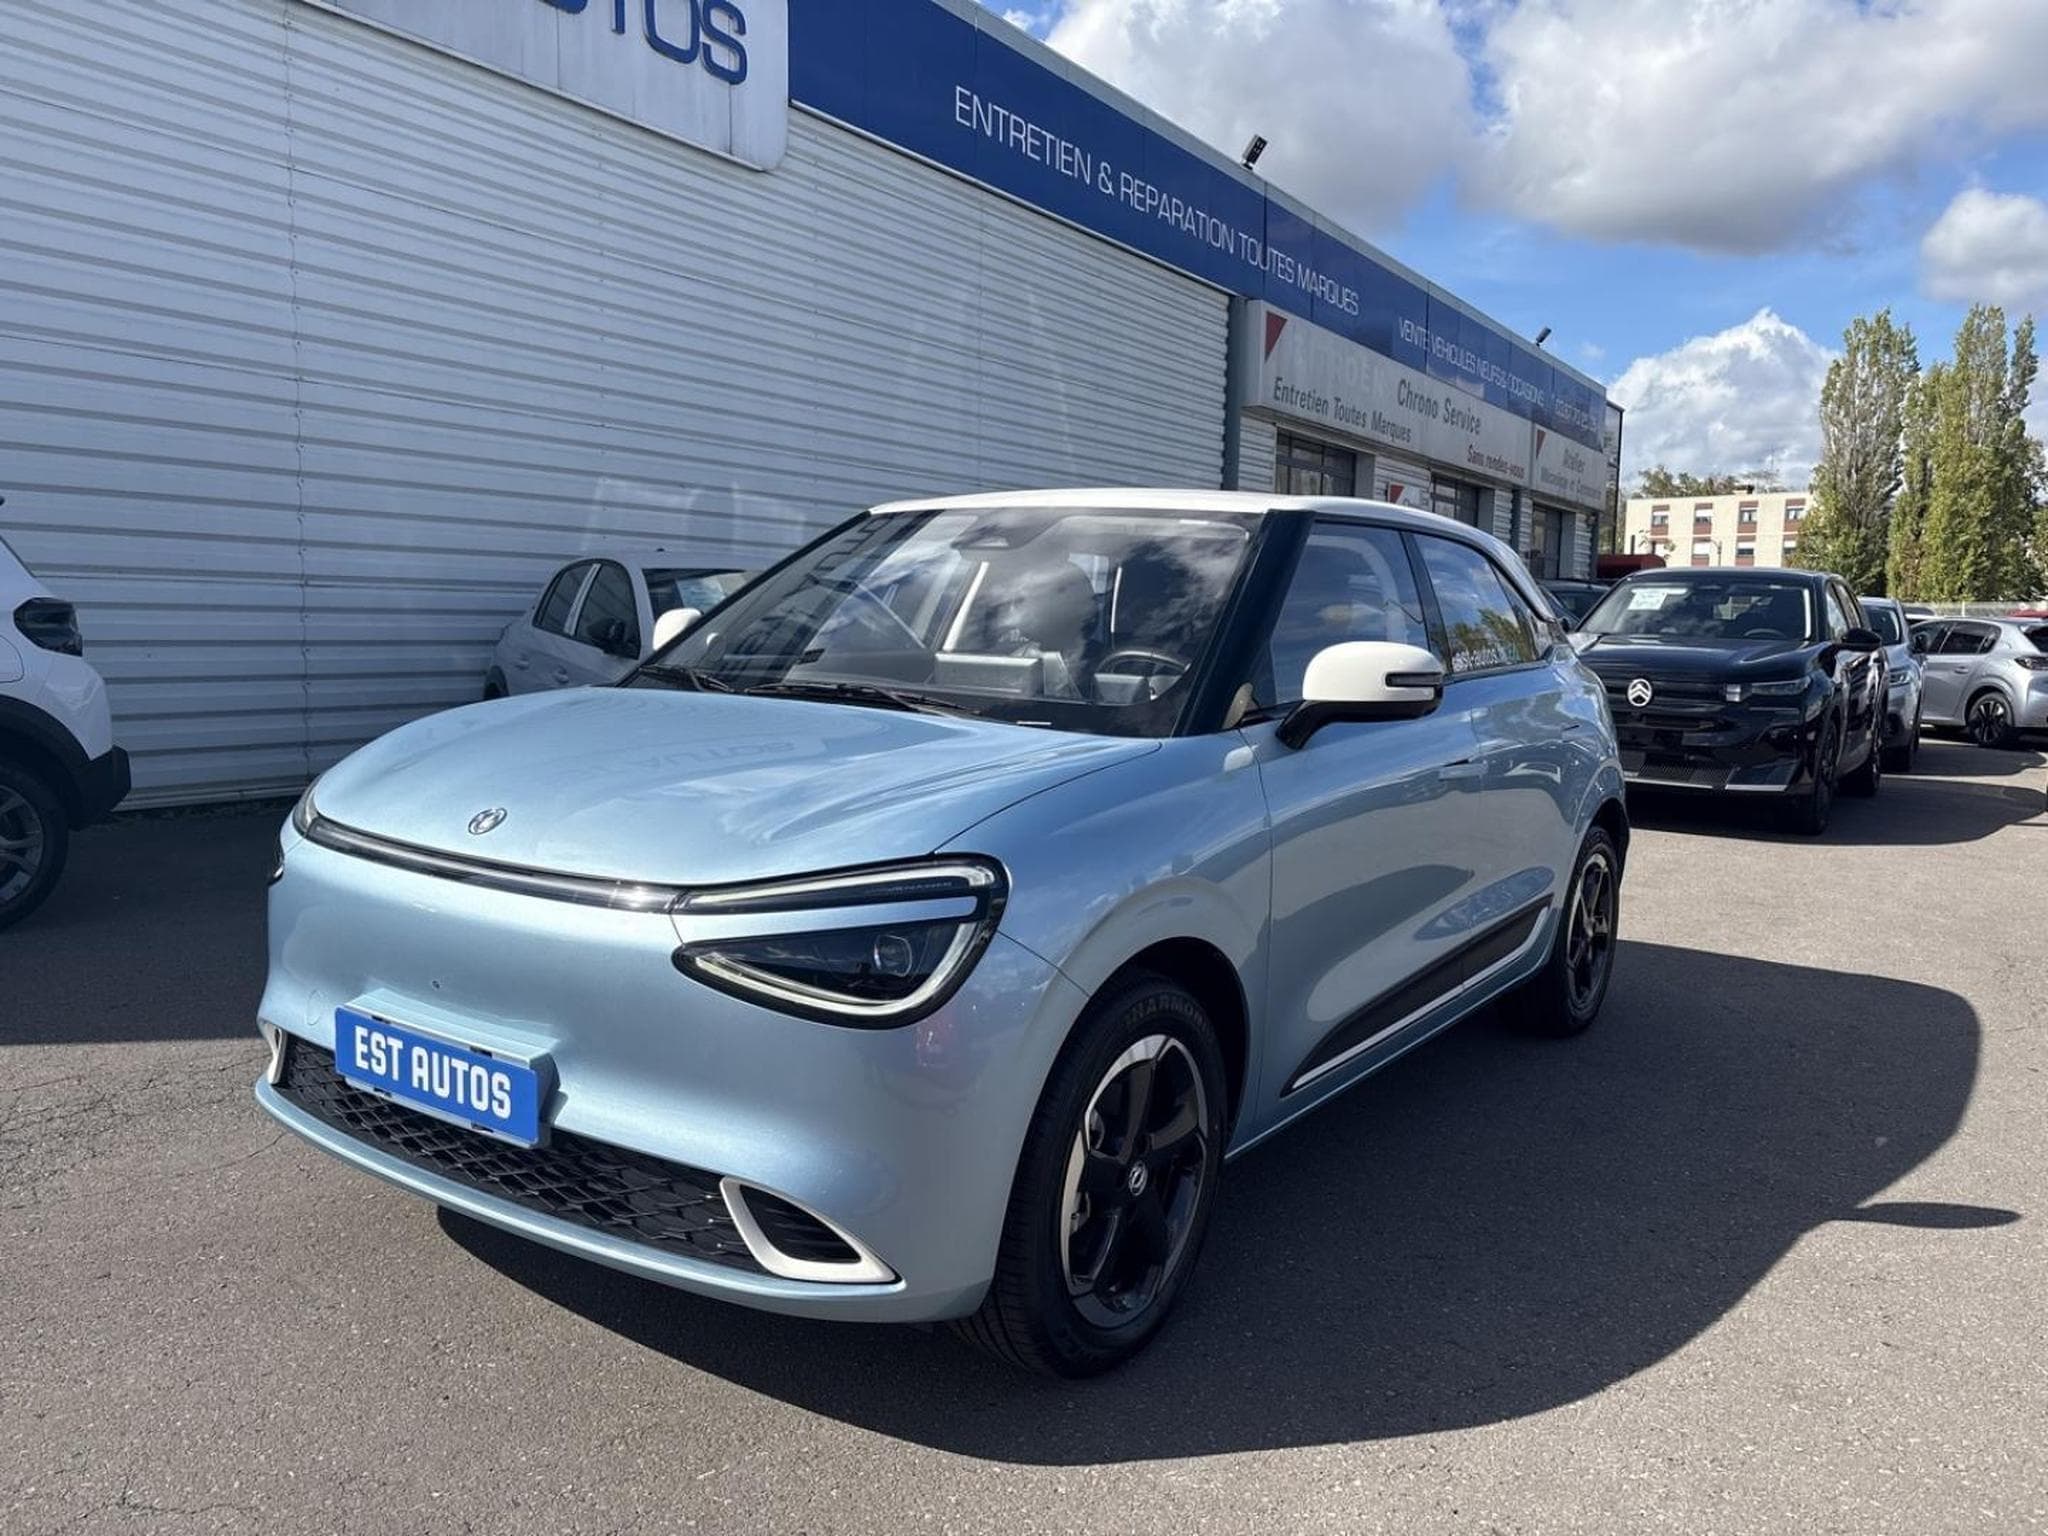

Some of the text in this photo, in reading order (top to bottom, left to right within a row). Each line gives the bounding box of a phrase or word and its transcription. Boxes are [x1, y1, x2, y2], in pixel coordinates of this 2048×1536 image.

[956, 85, 1359, 316] ENTRETIEN & REPARATION TOUTES MARQUES
[1273, 376, 1411, 443] Entretien Toutes Marques
[1397, 378, 1481, 435] Chrono Service
[355, 1025, 511, 1120] EST AUTOS
